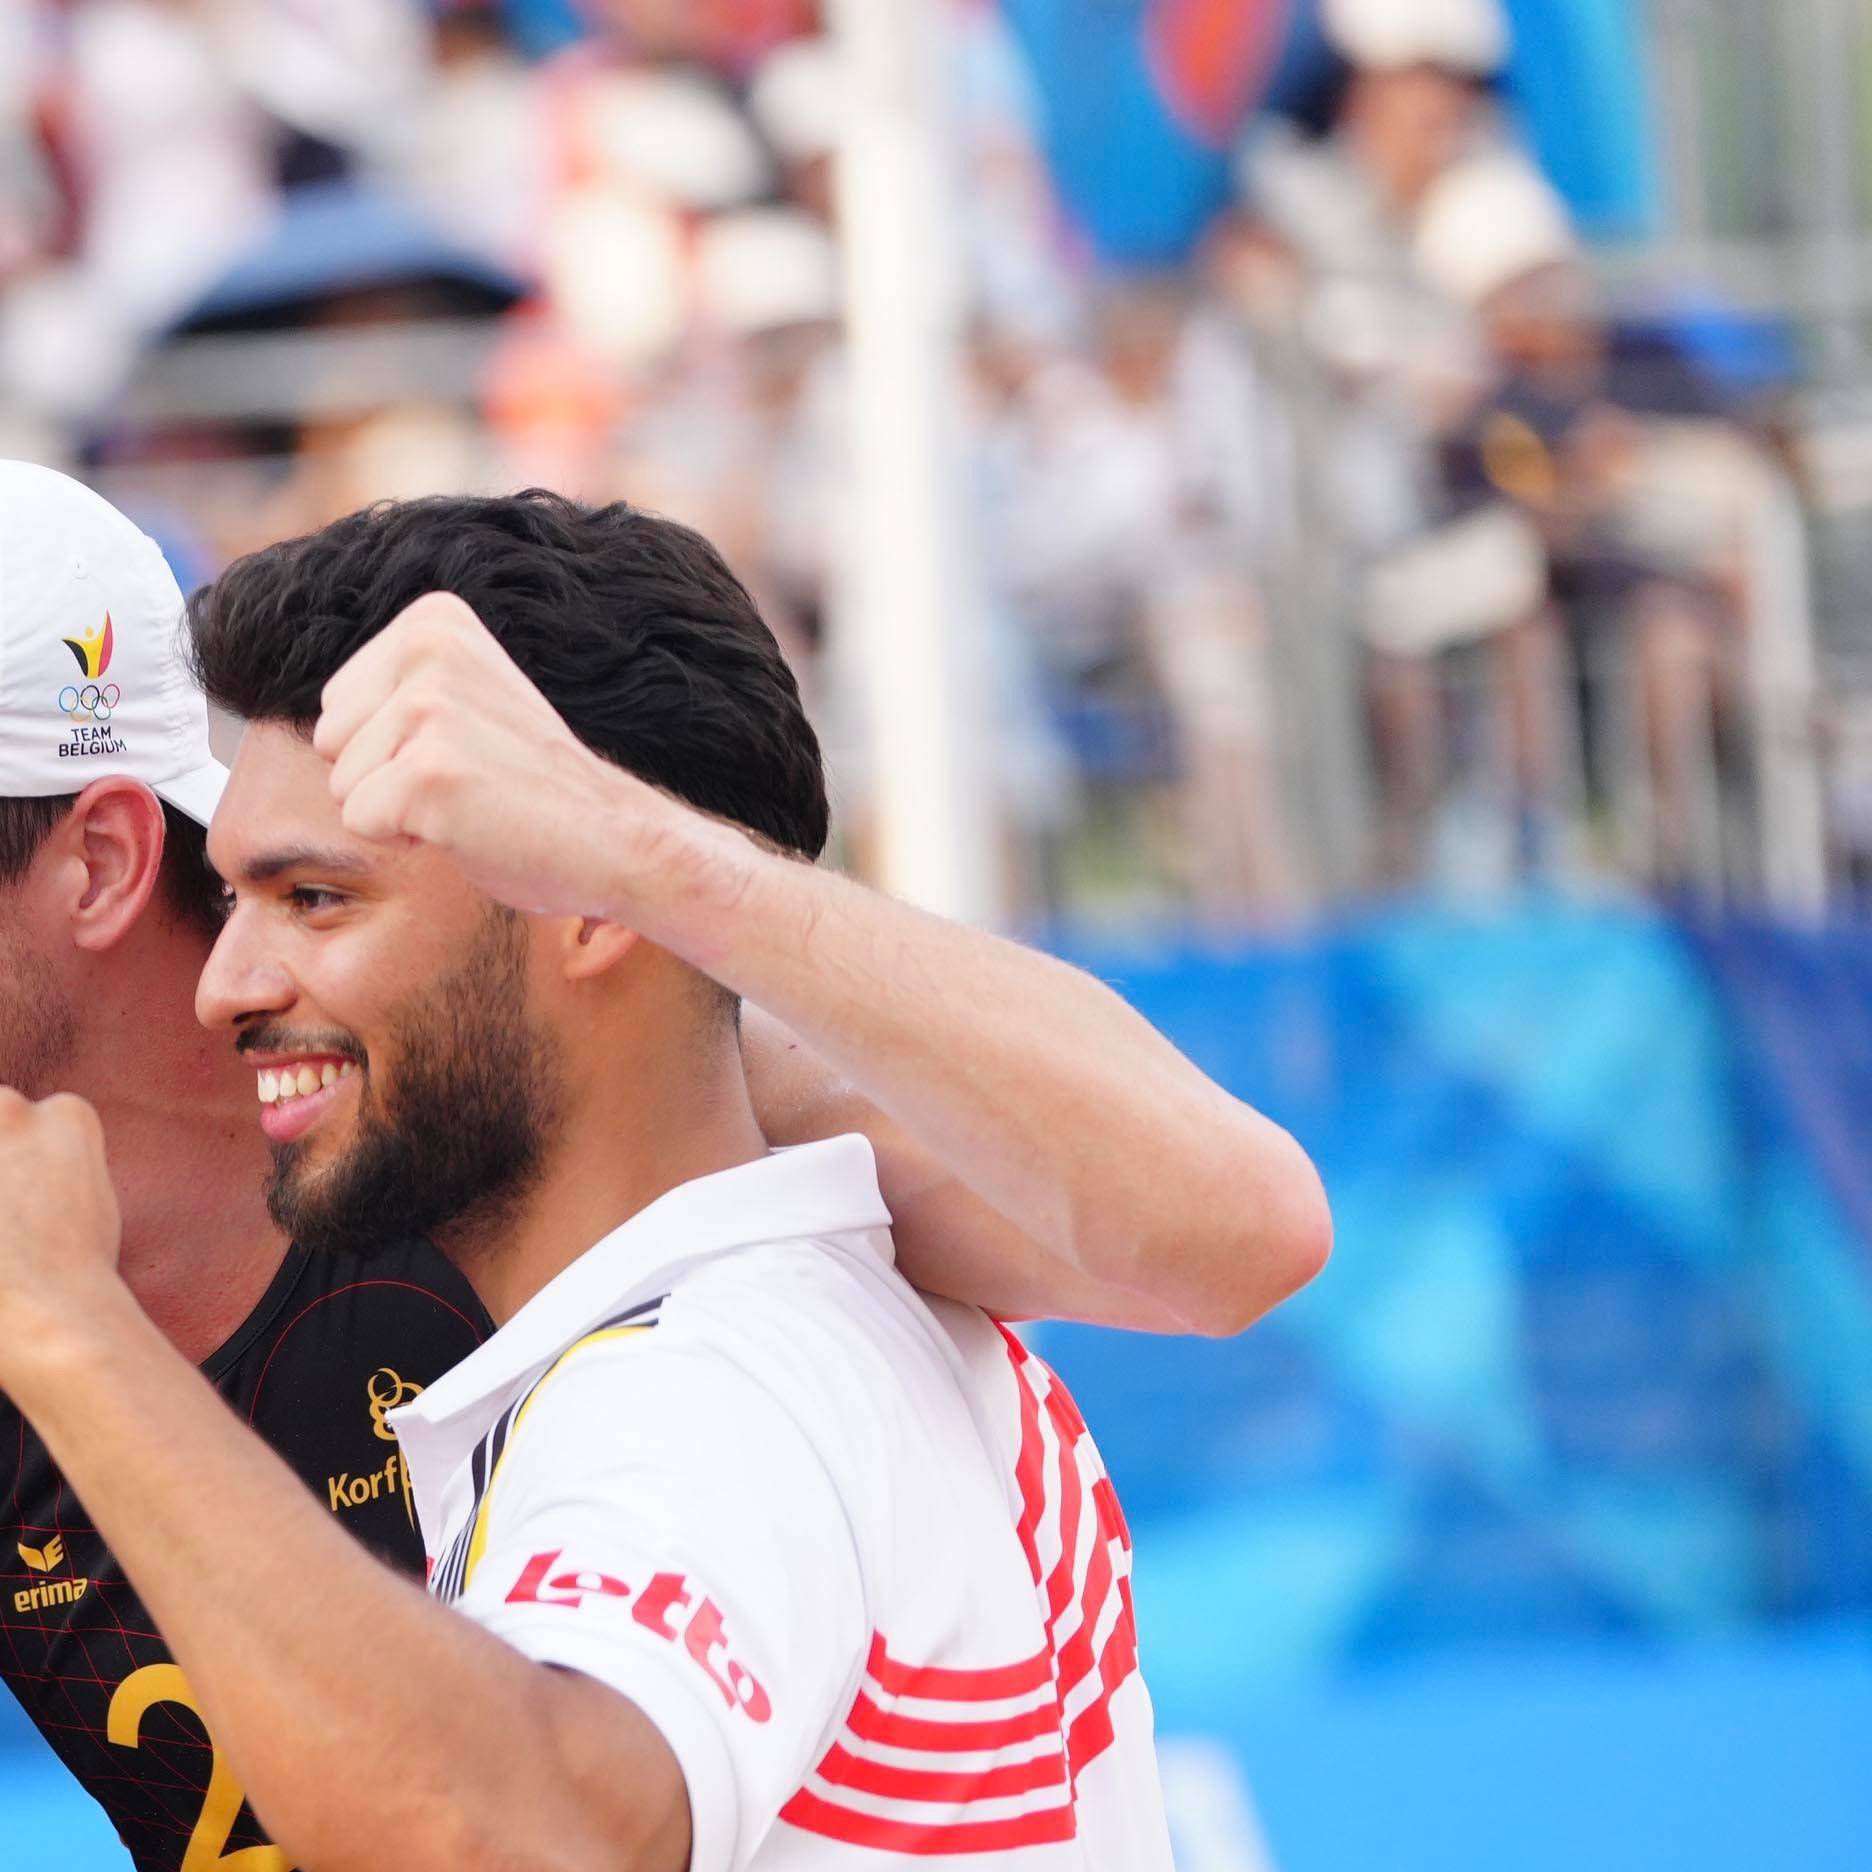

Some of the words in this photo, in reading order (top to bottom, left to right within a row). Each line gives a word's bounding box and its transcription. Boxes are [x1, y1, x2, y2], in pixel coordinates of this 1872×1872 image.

[71, 726, 112, 742] TEAM
[59, 739, 127, 758] BELGIUM
[14, 1577, 88, 1613] erima
